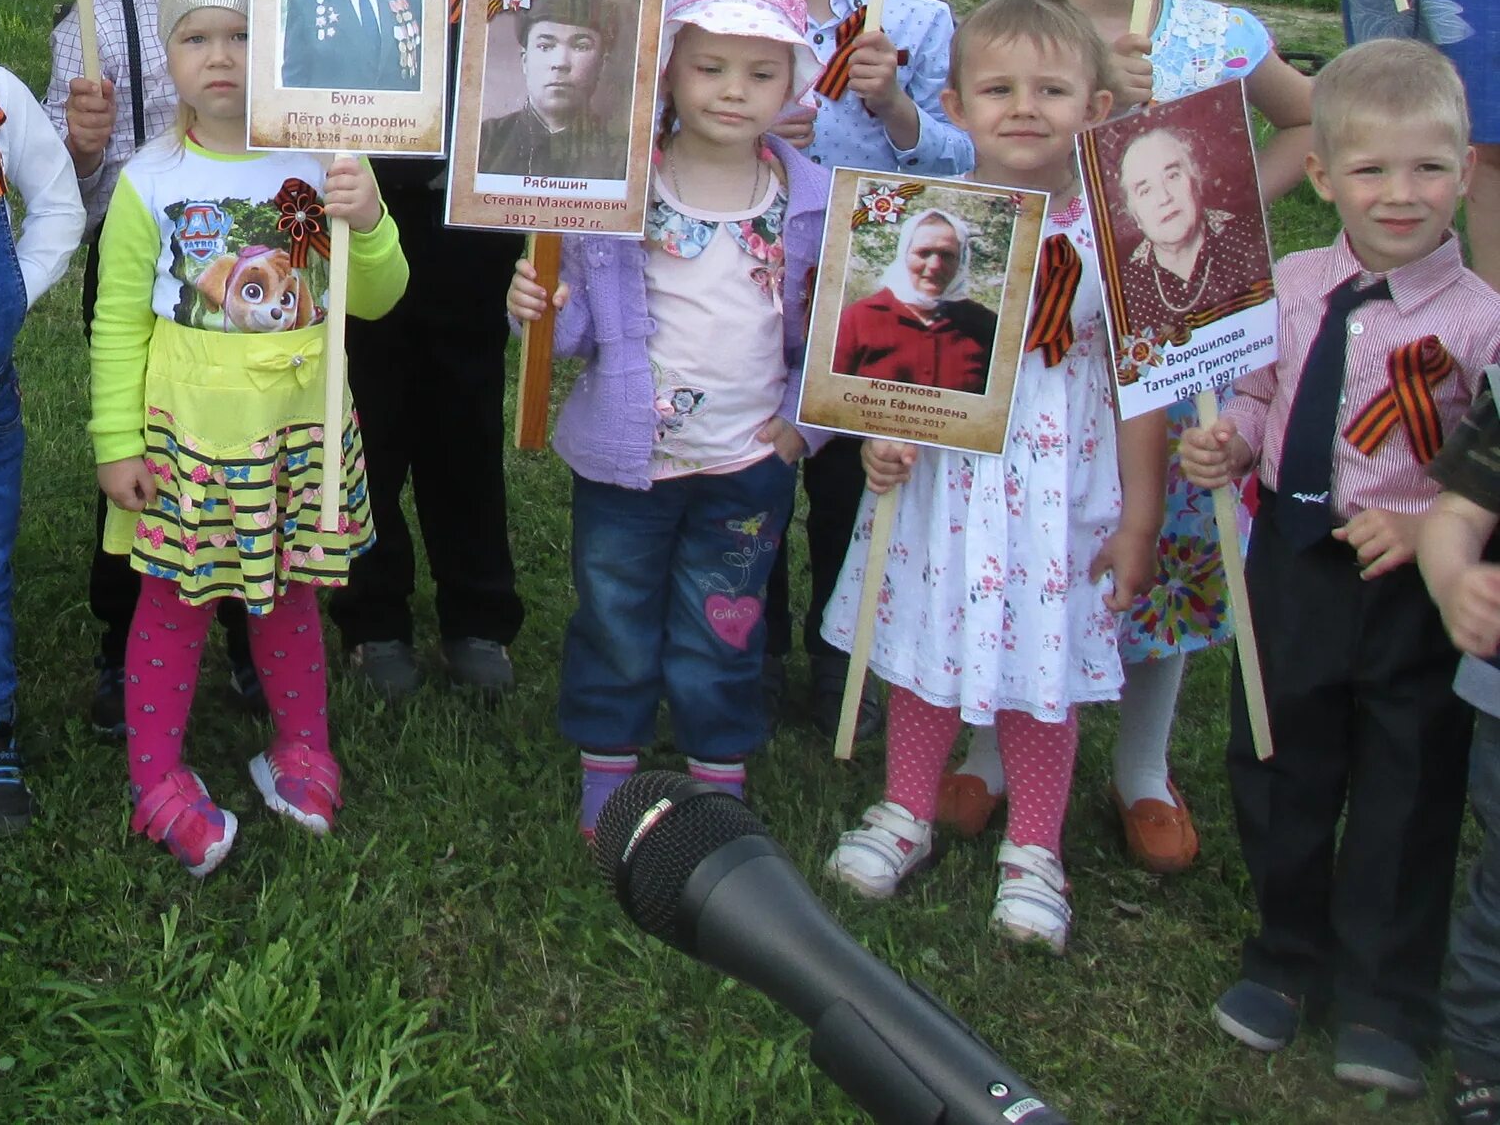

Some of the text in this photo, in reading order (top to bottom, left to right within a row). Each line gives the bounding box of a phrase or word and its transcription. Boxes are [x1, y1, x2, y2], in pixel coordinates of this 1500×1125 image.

[331, 92, 375, 107] Булах
[287, 112, 416, 129] Пётр Фёдорович
[523, 176, 587, 190] Рябишин
[483, 194, 627, 211] Степан Максимович
[504, 214, 536, 226] 1912
[554, 216, 585, 228] 1992
[590, 219, 604, 229] гг.
[184, 238, 219, 250] PATROL
[1166, 327, 1245, 366] Ворошилова
[1143, 334, 1274, 394] Татьяна Григорьевна
[870, 379, 941, 399] Короткова
[1174, 381, 1202, 402] 1920
[1239, 363, 1251, 375] гг.
[843, 392, 968, 420] София Ефимовена
